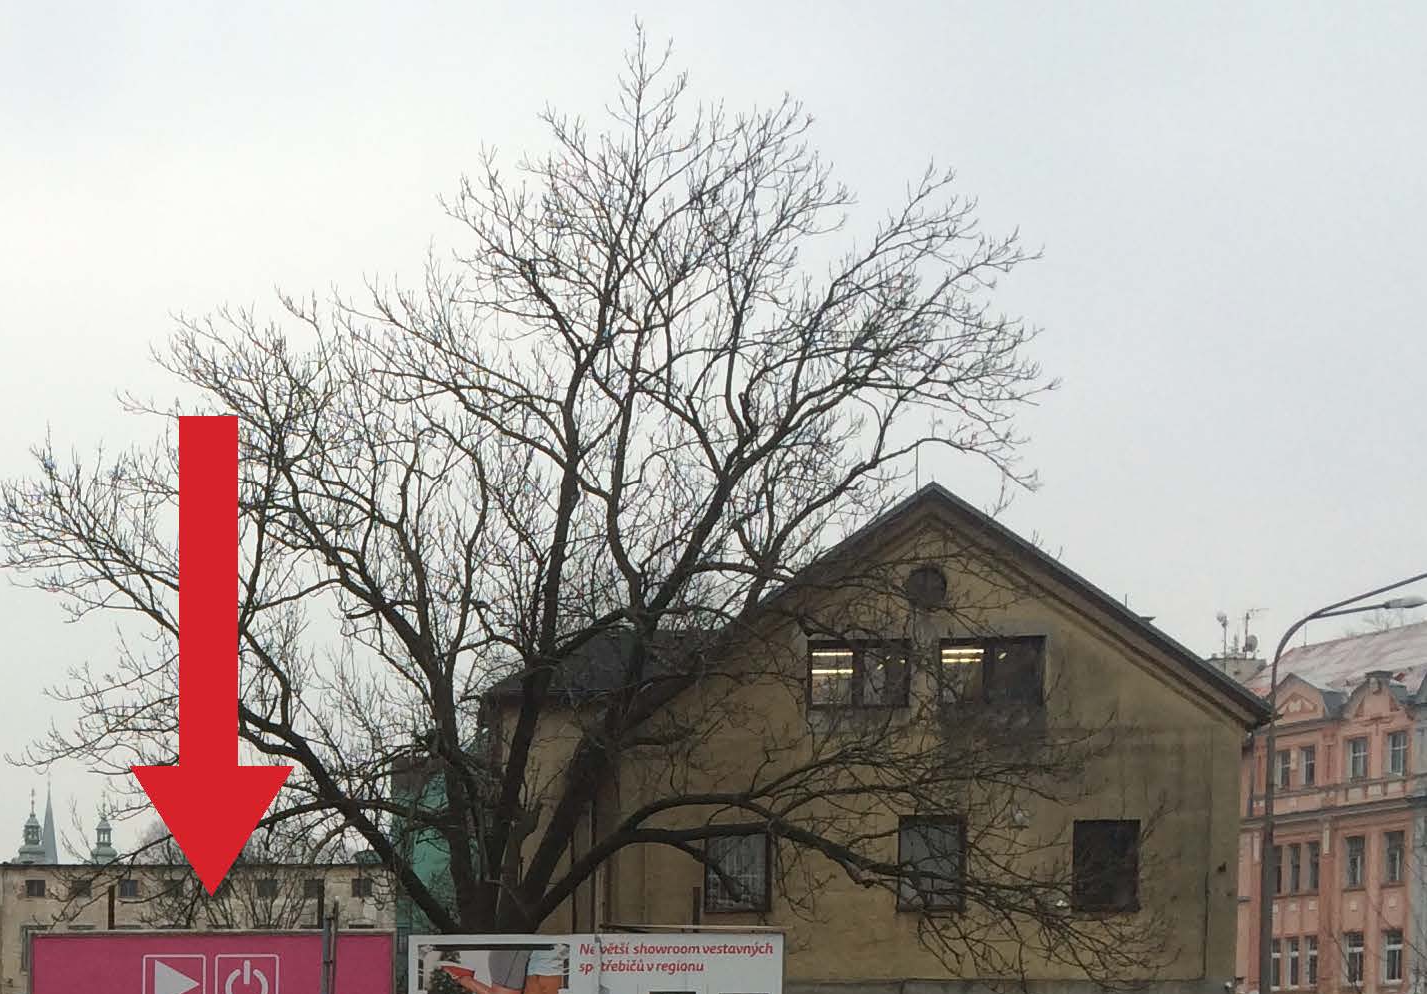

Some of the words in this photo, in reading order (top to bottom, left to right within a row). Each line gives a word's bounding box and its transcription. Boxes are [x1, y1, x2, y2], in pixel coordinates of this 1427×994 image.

[580, 943, 630, 955] Nevětší
[633, 943, 700, 954] showroom
[702, 942, 773, 957] vestavných
[579, 959, 644, 975] sptřebičů
[656, 961, 704, 974] regionu
